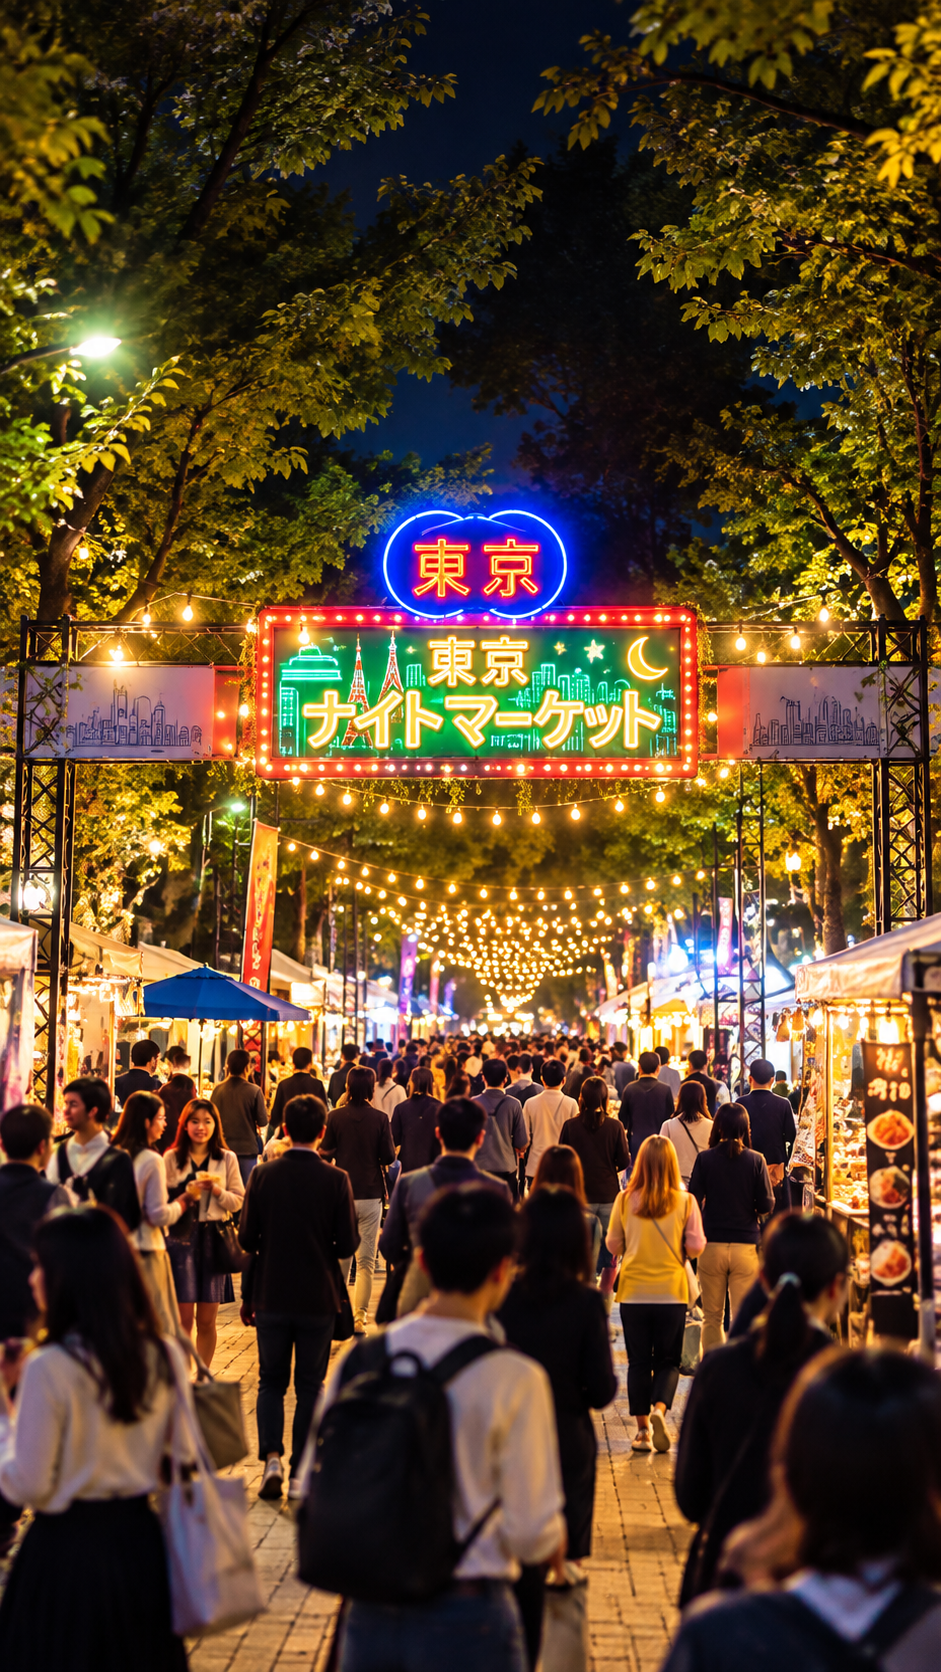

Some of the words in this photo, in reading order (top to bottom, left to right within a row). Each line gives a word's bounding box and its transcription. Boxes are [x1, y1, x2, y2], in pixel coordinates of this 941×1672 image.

[413, 538, 540, 598] 東京
[427, 634, 529, 687] 東京
[302, 689, 663, 750] ナイトマーケット
